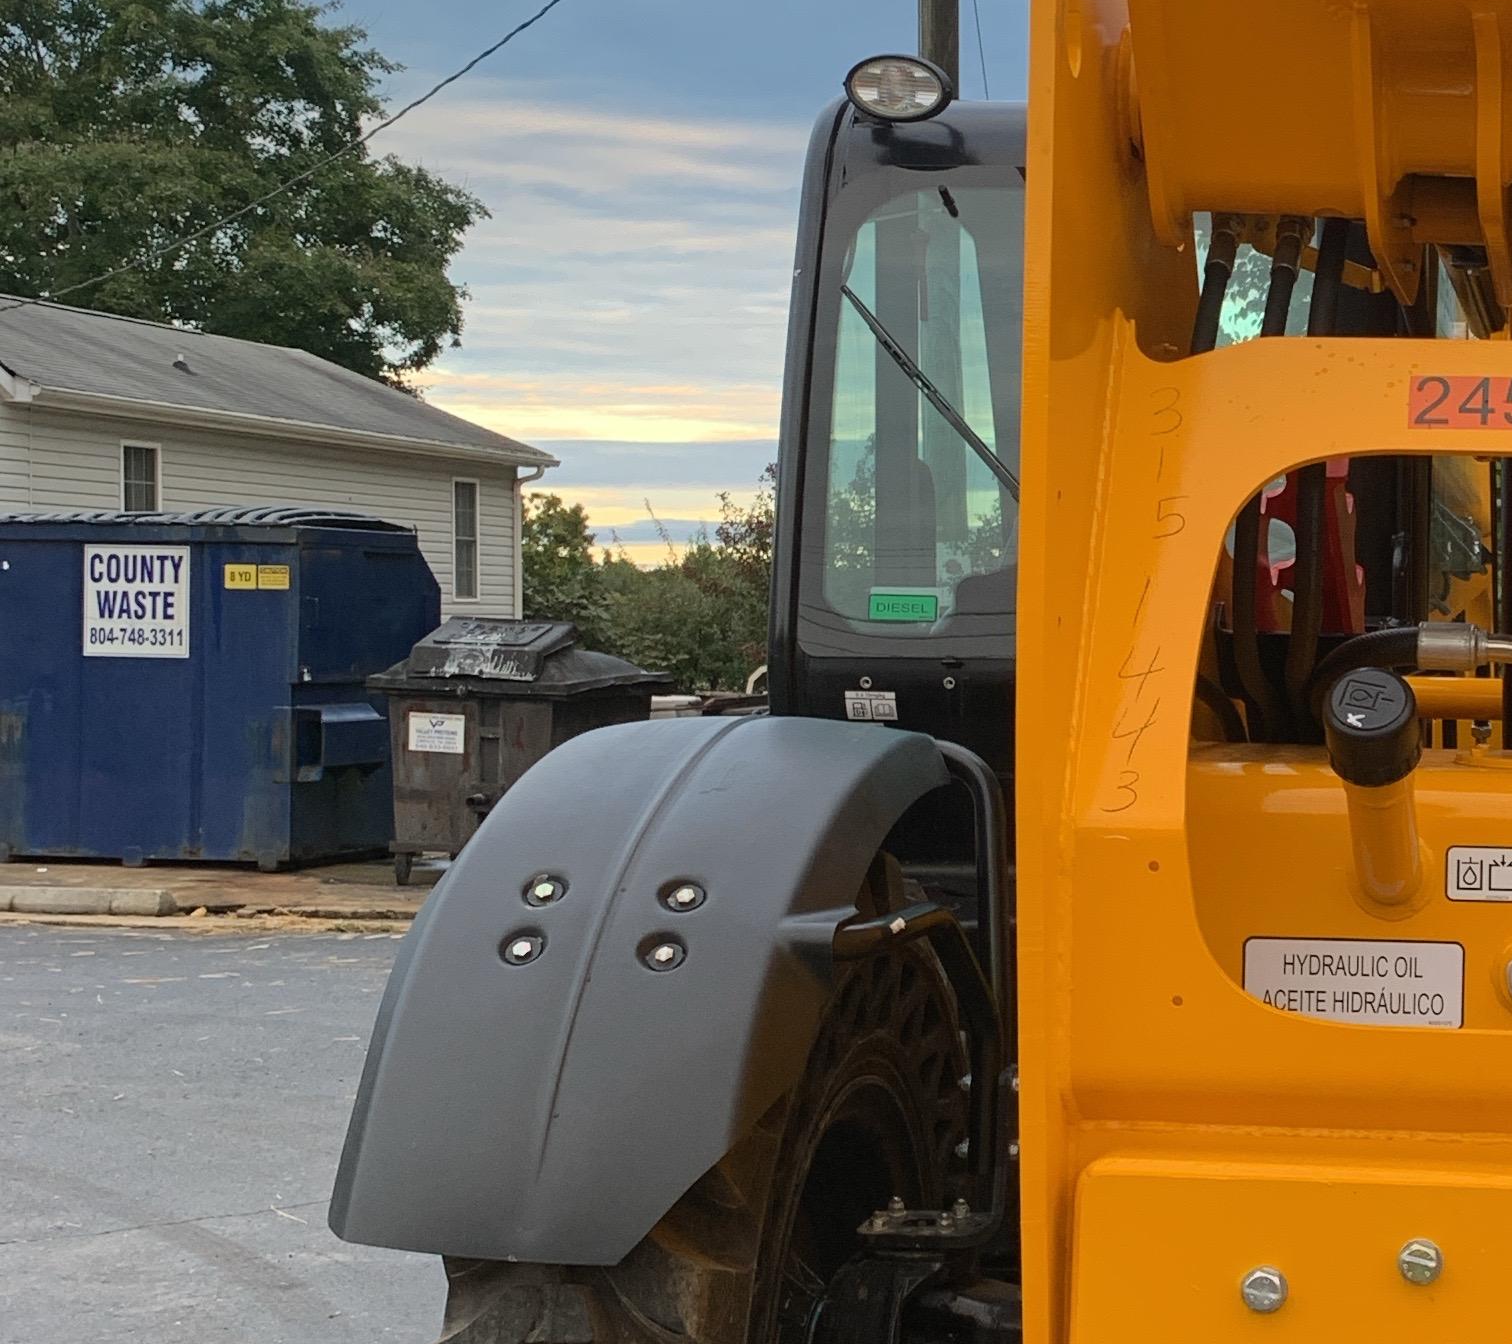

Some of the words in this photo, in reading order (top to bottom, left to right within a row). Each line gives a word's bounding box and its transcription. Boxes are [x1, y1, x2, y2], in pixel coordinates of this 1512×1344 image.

[90, 553, 184, 584] COUNTY
[96, 590, 175, 620] WASTE
[876, 602, 929, 614] DIESEL
[90, 627, 184, 646] 804-748-3311
[1283, 954, 1389, 977] HYDRAULIC
[1394, 956, 1424, 979] OIL
[1263, 989, 1327, 1012] ACEITE
[1333, 987, 1445, 1016] HIDRÁULICO
